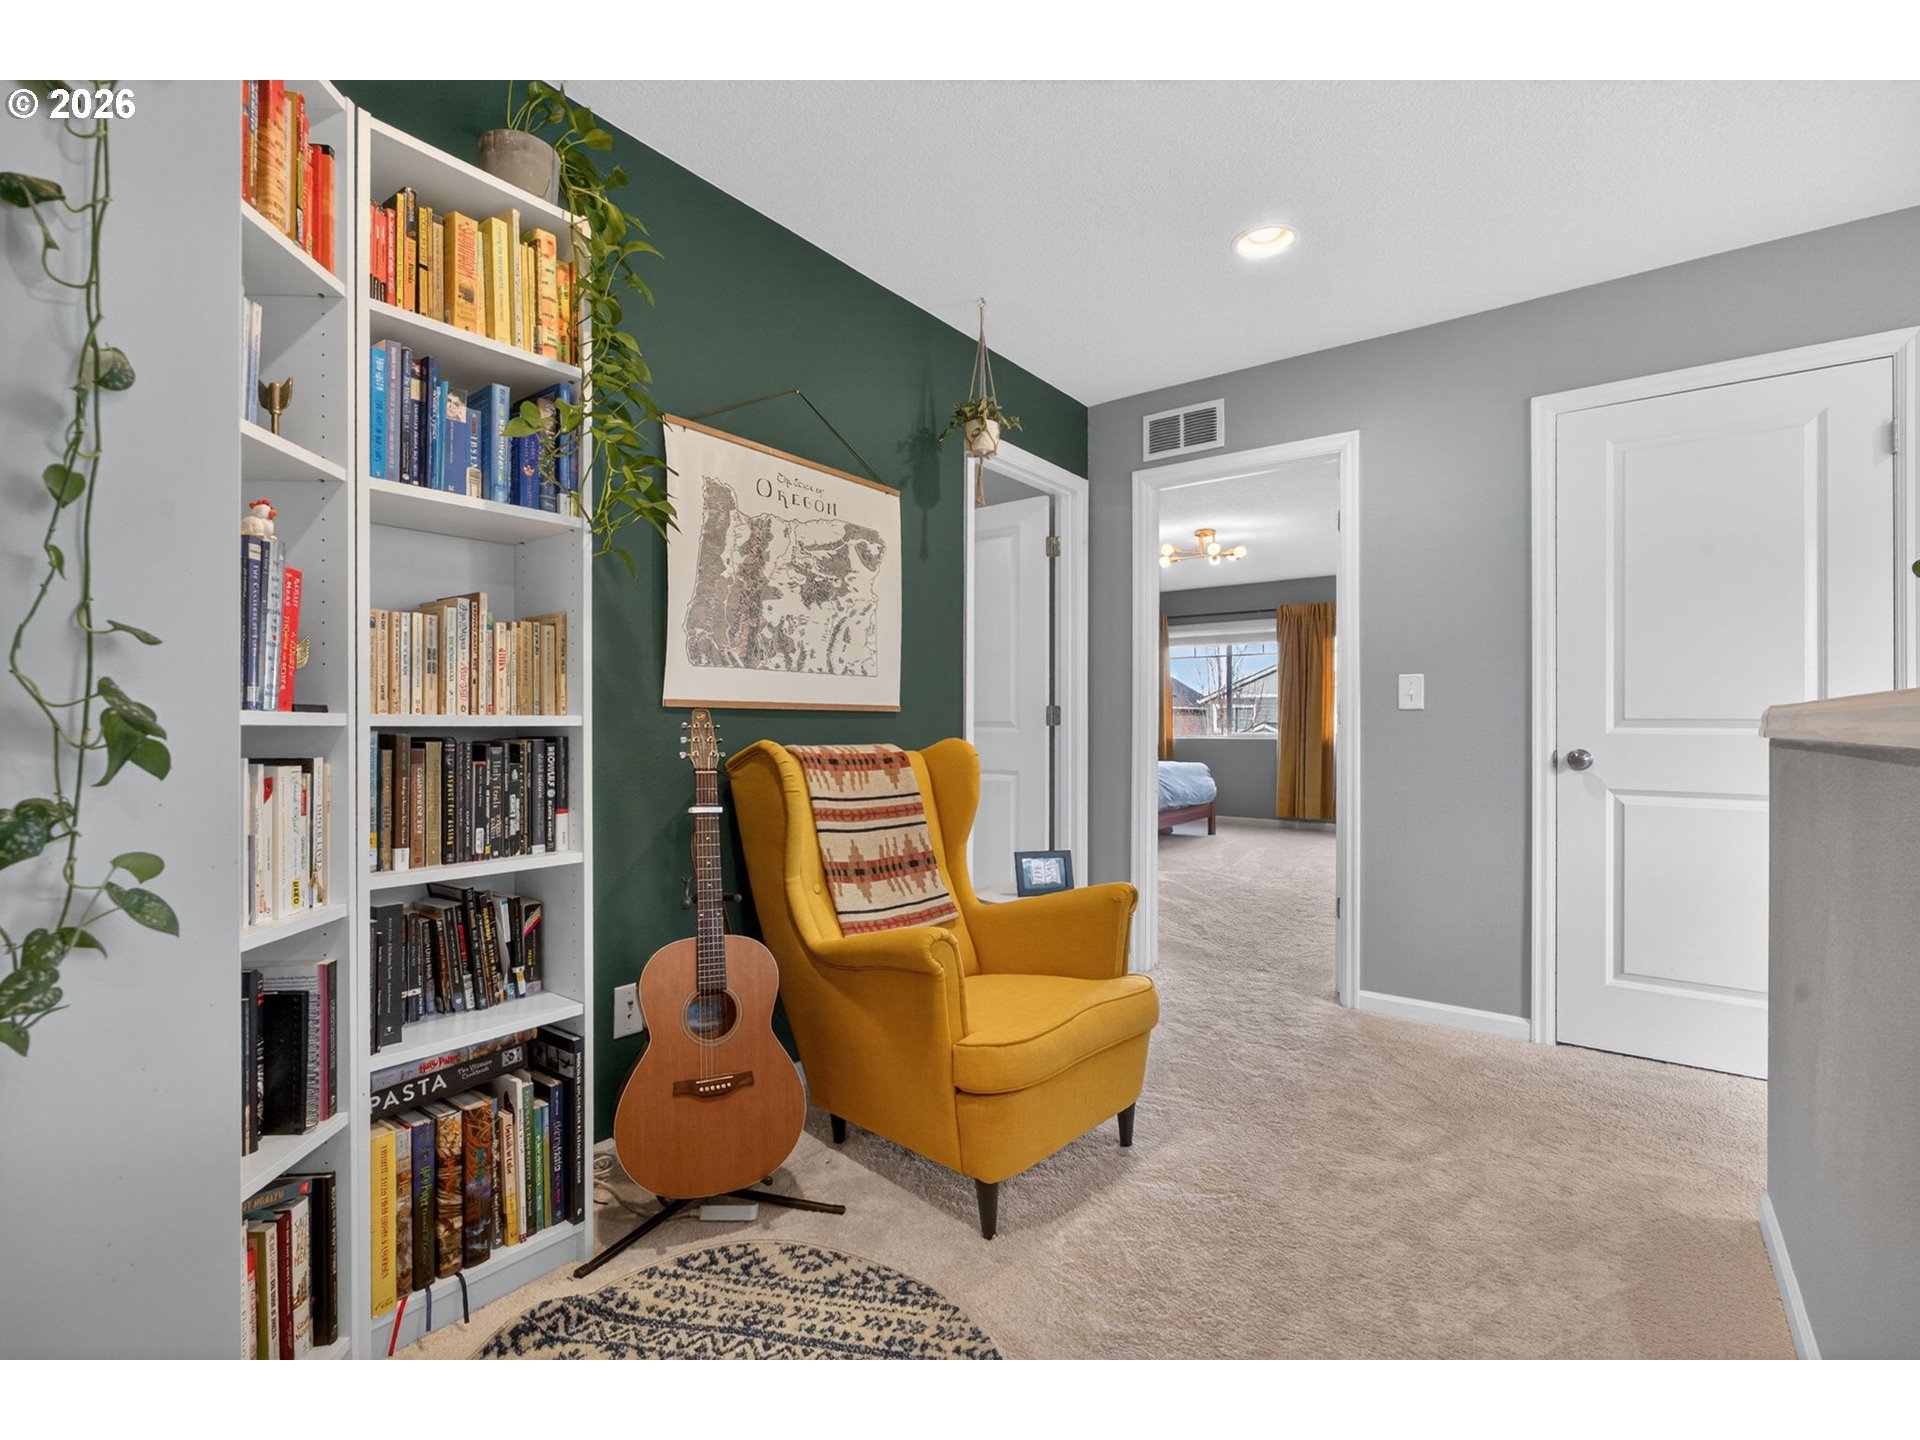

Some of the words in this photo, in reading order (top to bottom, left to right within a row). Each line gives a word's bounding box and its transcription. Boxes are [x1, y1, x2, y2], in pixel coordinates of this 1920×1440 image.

[755, 477, 838, 517] OREGON
[776, 471, 792, 488] The
[370, 1073, 448, 1110] PASTA
